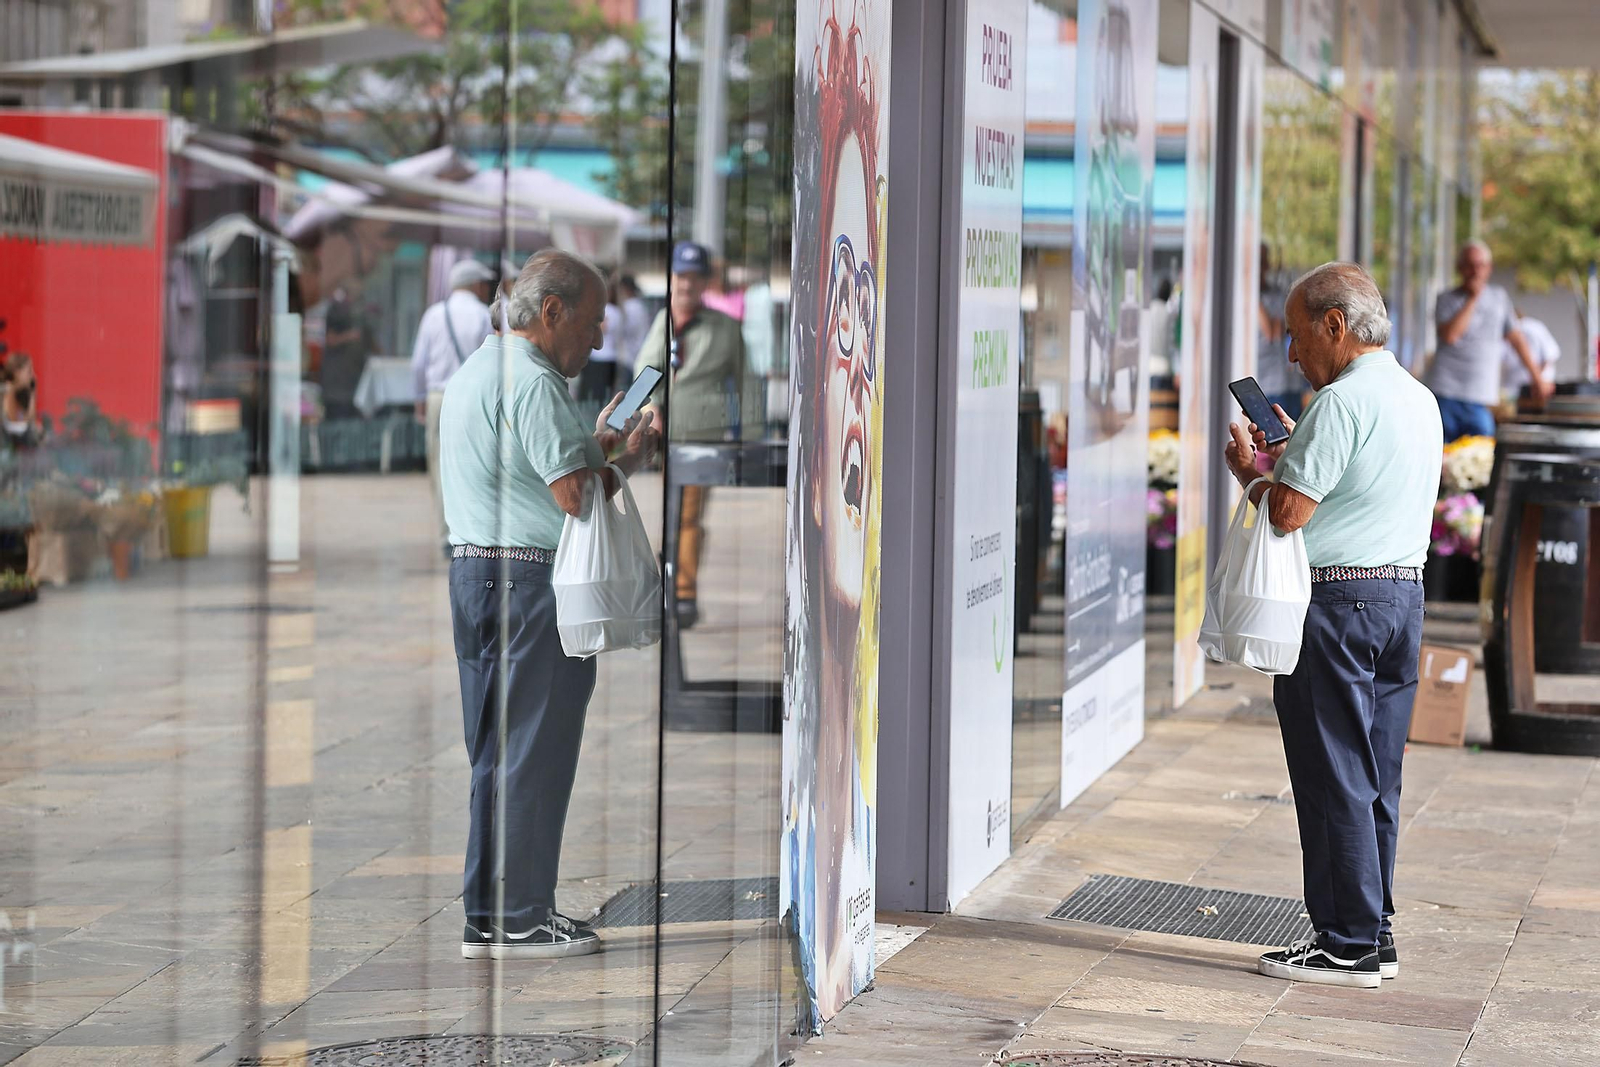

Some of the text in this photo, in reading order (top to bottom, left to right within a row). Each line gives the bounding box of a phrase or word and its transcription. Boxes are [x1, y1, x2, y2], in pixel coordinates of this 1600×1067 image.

[983, 24, 1012, 90] PRUEBA
[974, 126, 1015, 190] NUESTRAS
[965, 228, 1018, 288] PROGRESIVAS
[972, 330, 1008, 389] PREMIUM
